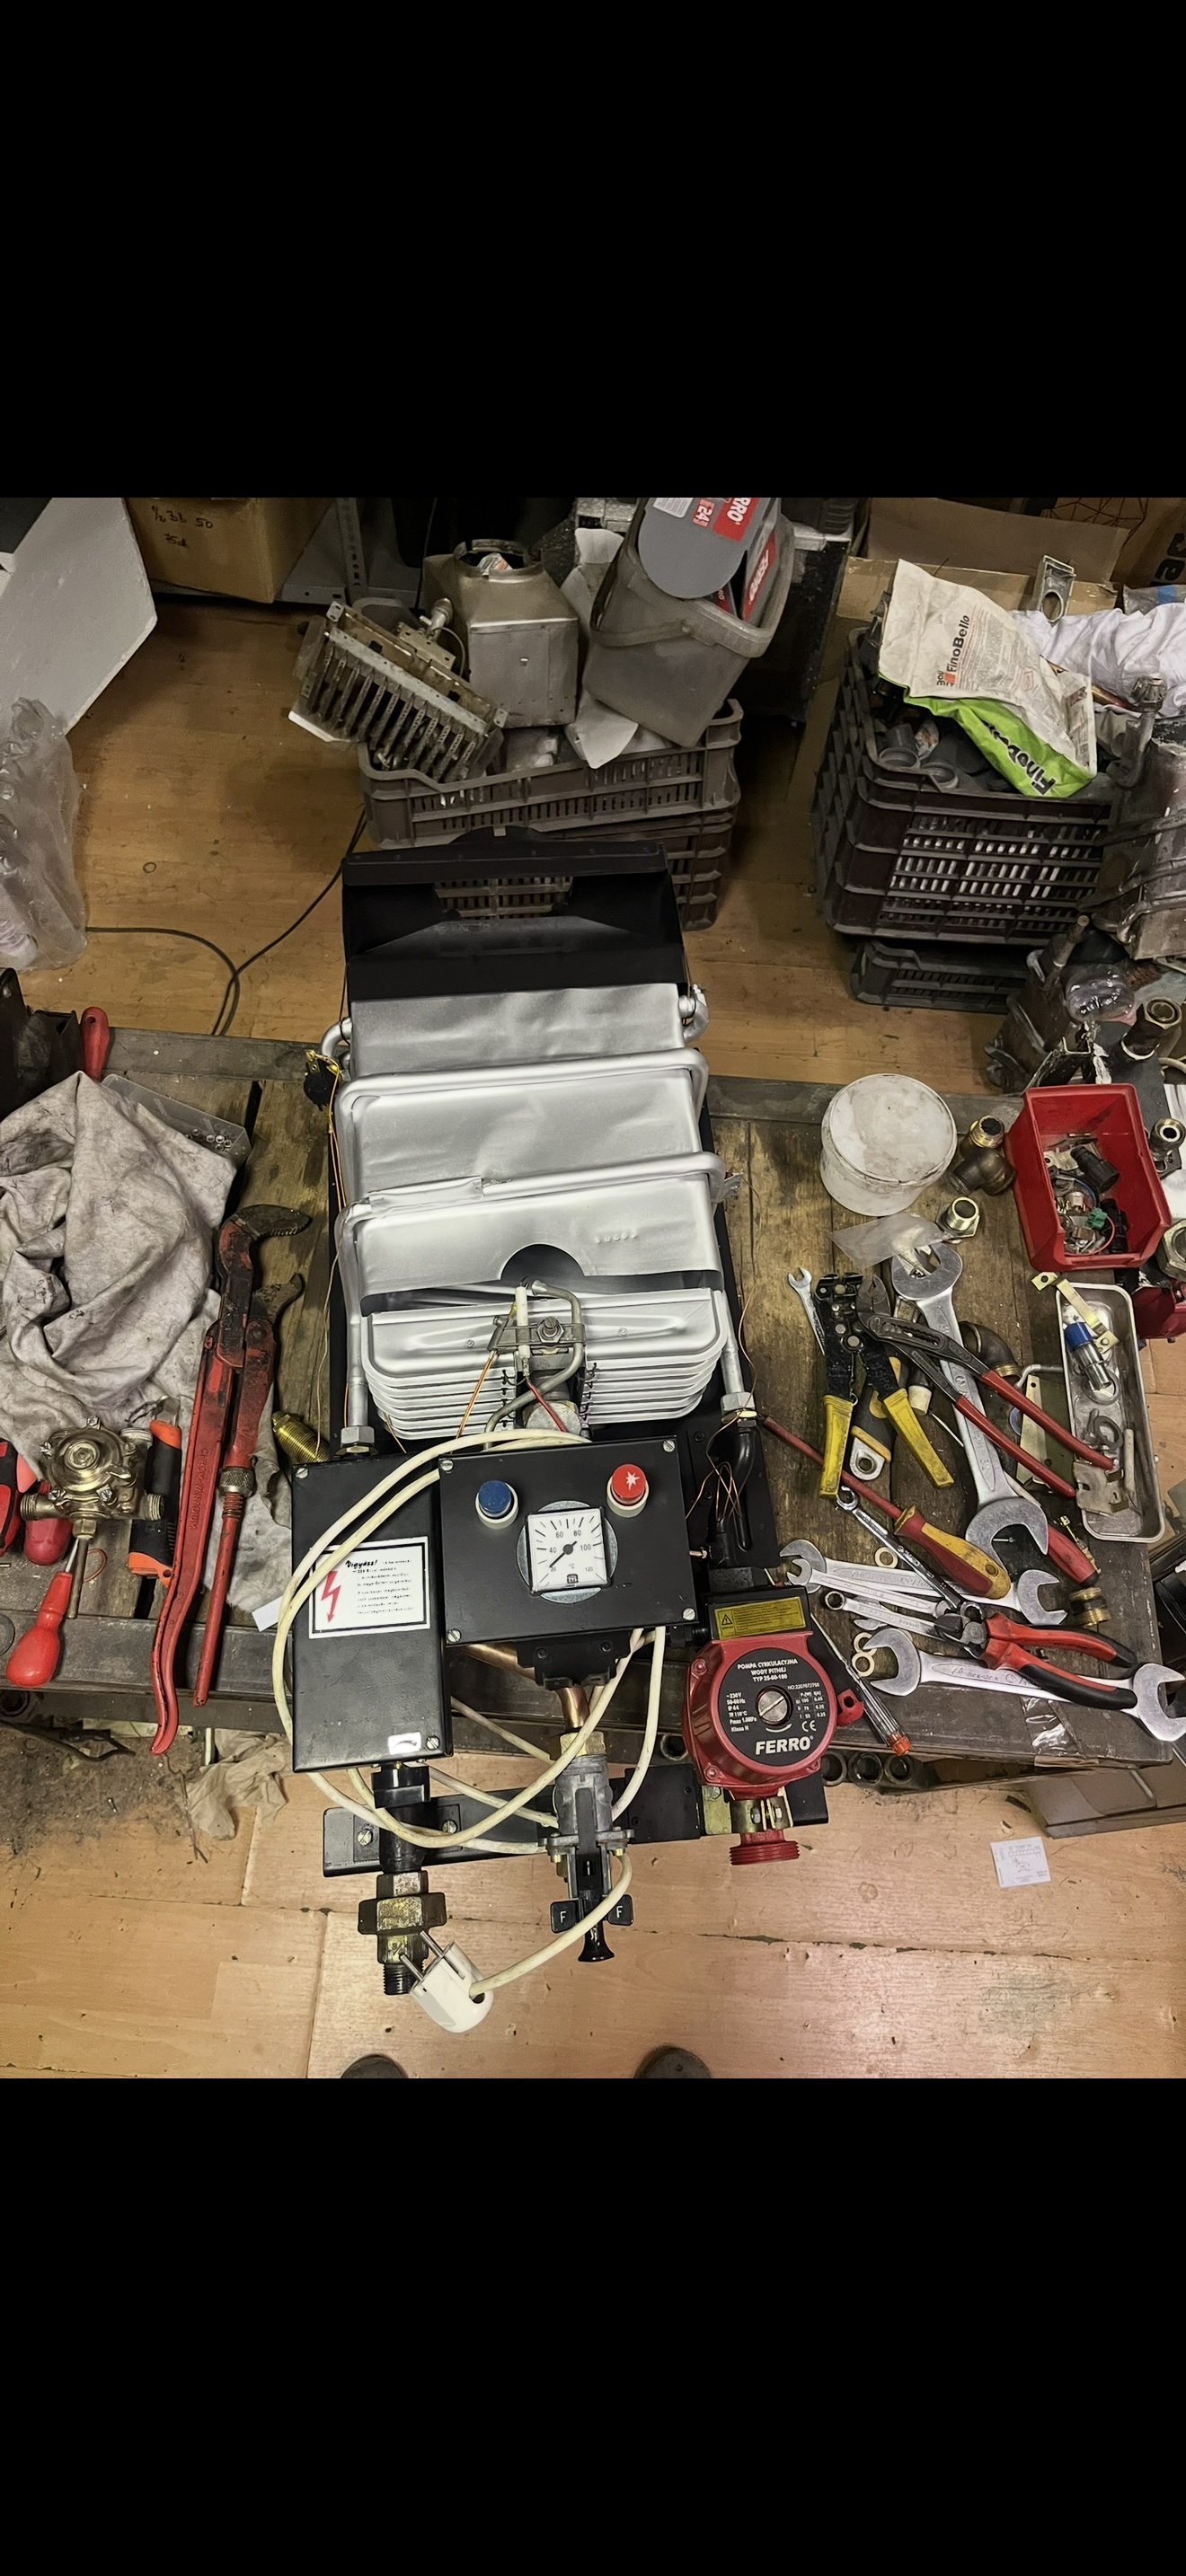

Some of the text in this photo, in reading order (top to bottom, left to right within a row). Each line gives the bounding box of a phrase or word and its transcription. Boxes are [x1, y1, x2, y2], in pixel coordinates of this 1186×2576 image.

[946, 614, 970, 673] FinoBello
[555, 1531, 564, 1539] 60
[580, 1543, 592, 1551] 100
[755, 1736, 810, 1755] FERRO
[560, 1910, 567, 1924] F
[615, 1905, 624, 1919] F
